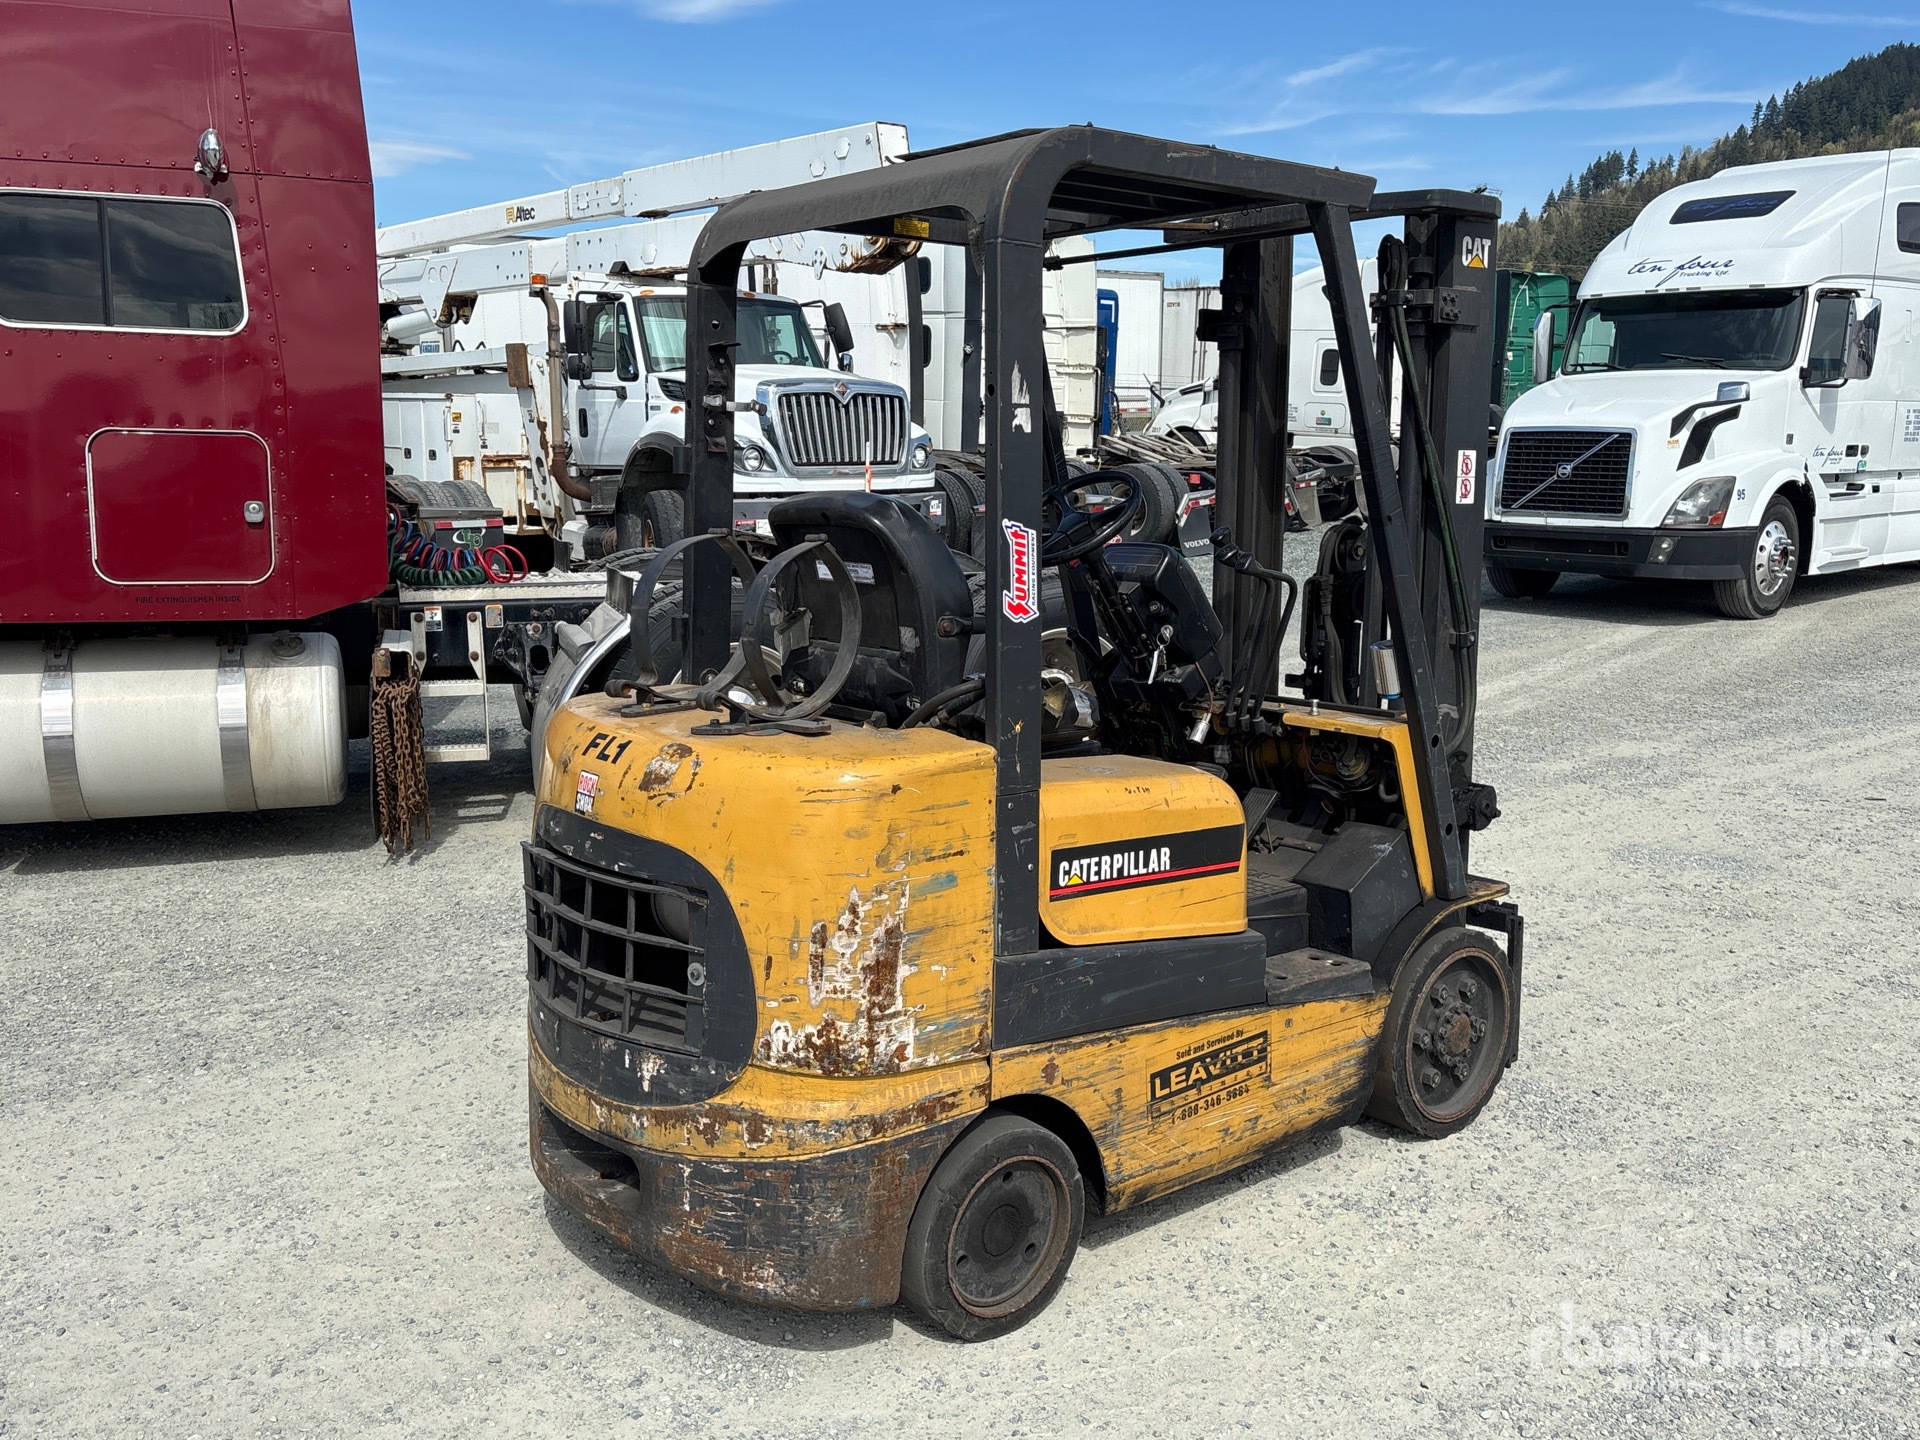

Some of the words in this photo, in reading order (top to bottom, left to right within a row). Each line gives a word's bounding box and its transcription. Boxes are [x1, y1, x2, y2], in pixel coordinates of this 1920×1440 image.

[516, 205, 535, 222] Altec
[1461, 235, 1492, 269] CAT
[1627, 257, 1673, 275] ten
[1655, 255, 1735, 288] four
[1812, 444, 1827, 457] ten
[1736, 488, 1746, 501] 95
[1183, 538, 1210, 549] VOLVO
[135, 596, 154, 604] FIRE
[155, 595, 214, 604] EXTINGUISHER
[215, 594, 242, 603] INSIDE
[581, 732, 634, 765] FL1
[1058, 847, 1171, 888] CATERPILLAR
[1176, 1045, 1192, 1060] Sold
[1193, 1043, 1206, 1055] and
[1206, 1033, 1234, 1049] Serviced
[1235, 1029, 1244, 1038] By
